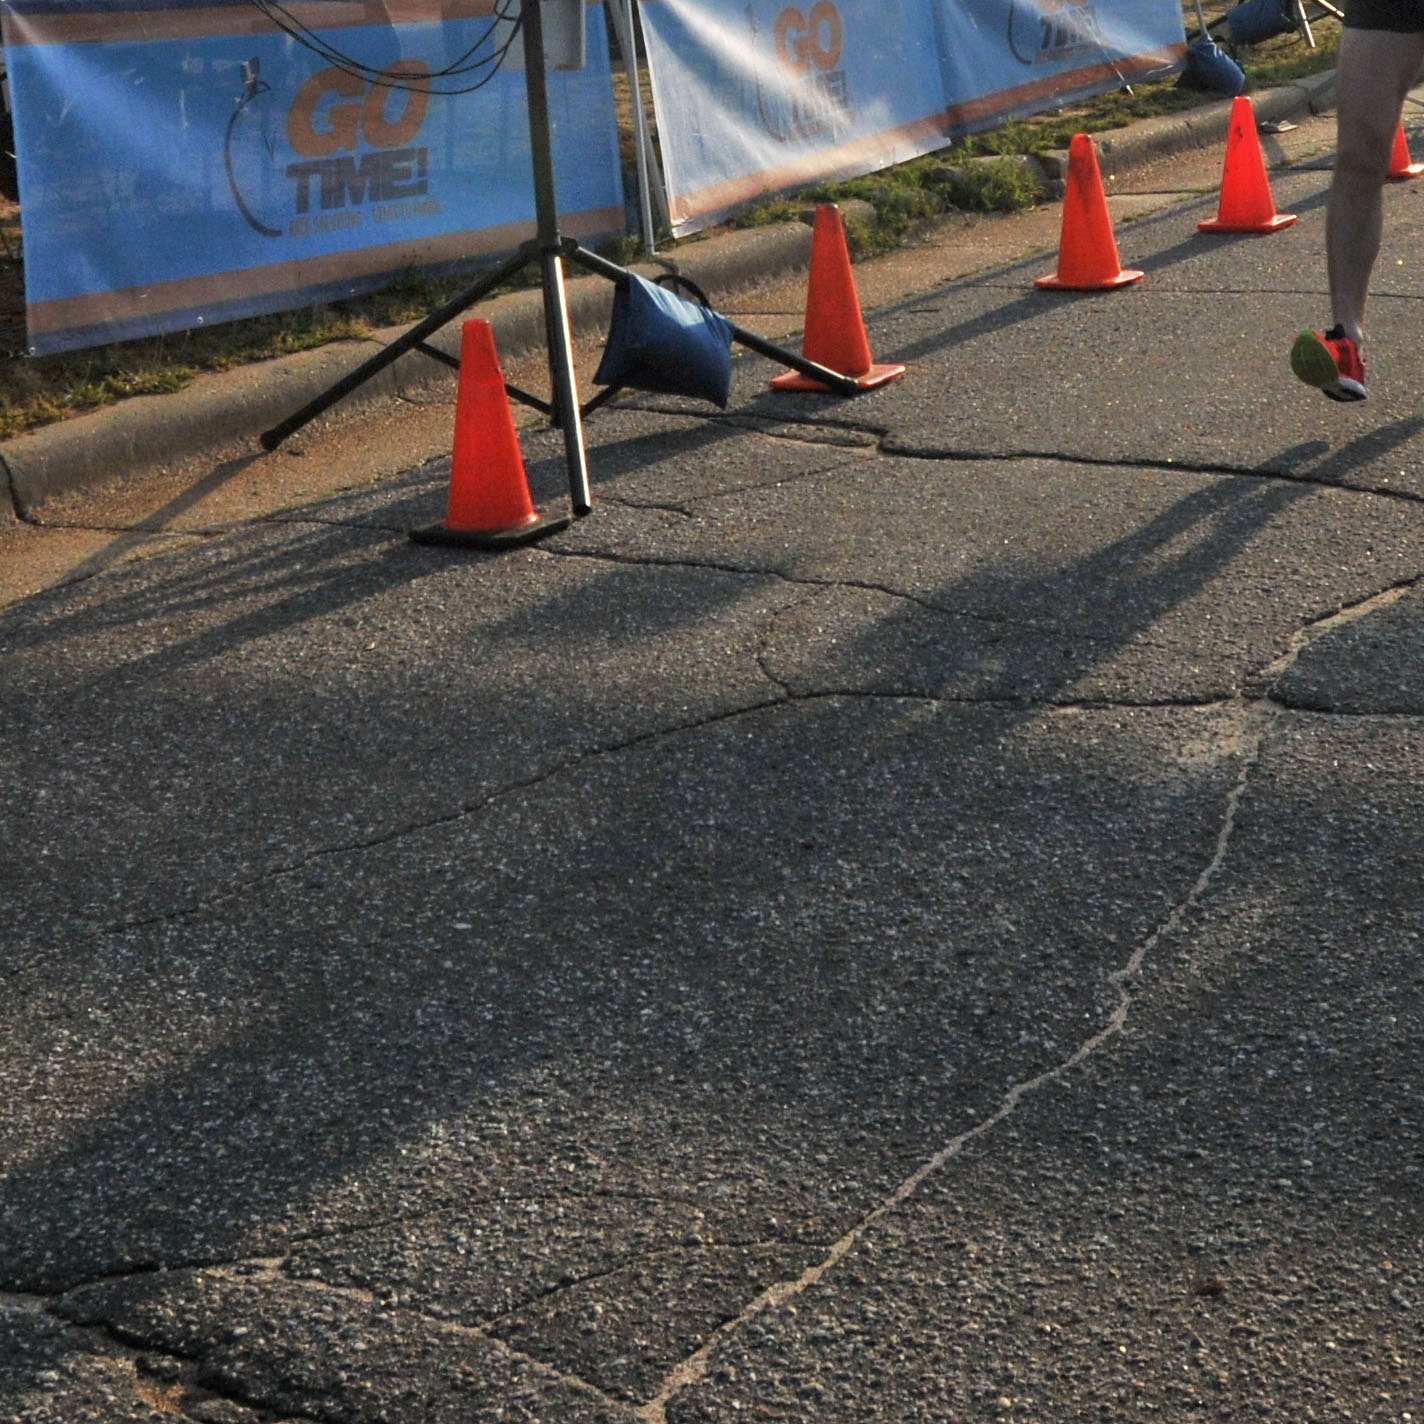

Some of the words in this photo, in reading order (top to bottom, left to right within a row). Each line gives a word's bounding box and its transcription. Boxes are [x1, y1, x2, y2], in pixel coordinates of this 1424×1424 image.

[775, 0, 844, 80] GO
[286, 59, 432, 158] GO
[286, 147, 429, 216] TIME!
